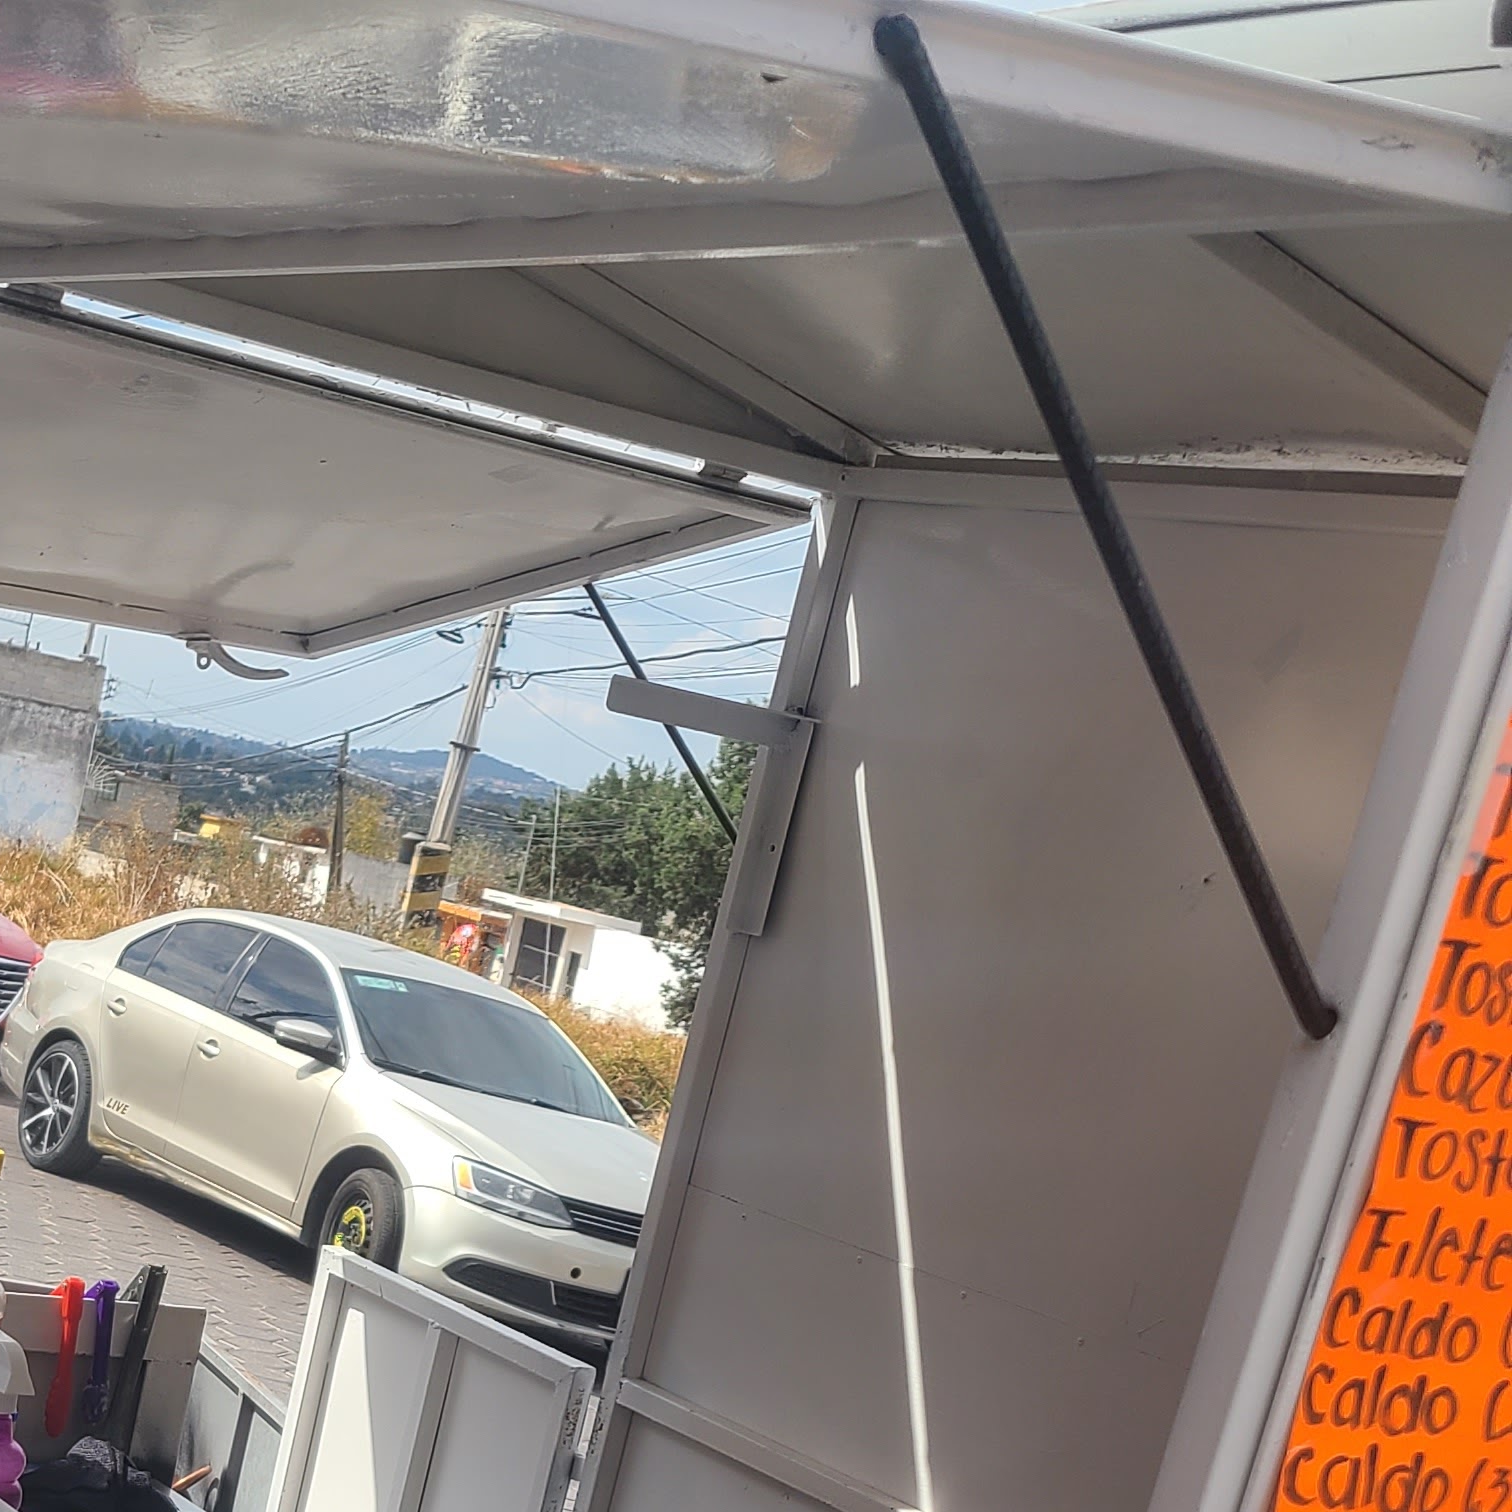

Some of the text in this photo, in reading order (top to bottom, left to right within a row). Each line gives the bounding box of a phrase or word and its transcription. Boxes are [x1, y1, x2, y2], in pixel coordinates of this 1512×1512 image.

[106, 1097, 130, 1115] LIVE
[1320, 1285, 1480, 1364] Caldo
[1300, 1362, 1458, 1437] Caldo
